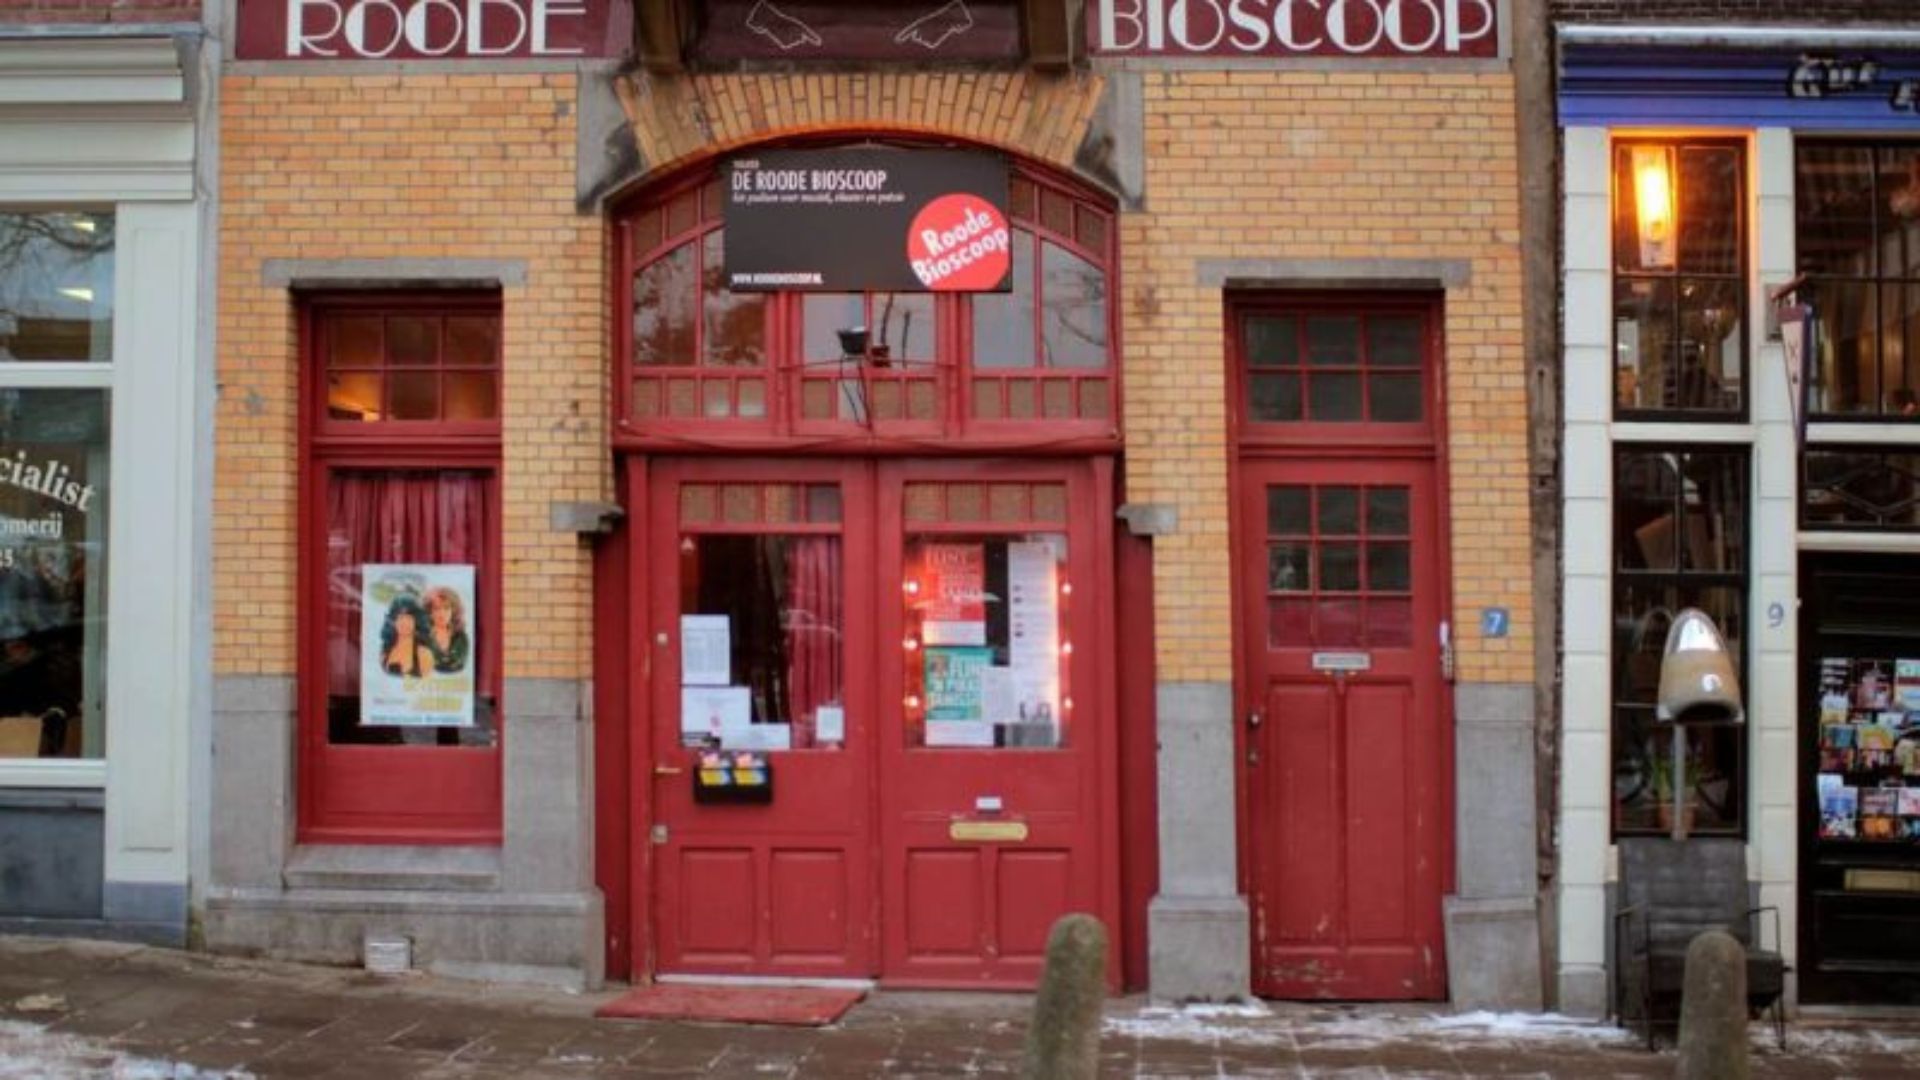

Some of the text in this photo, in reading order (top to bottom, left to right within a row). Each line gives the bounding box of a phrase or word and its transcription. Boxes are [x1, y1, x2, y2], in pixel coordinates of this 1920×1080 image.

[287, 0, 586, 57] ROODE
[1101, 0, 1493, 53] BIOSCOOP
[732, 170, 887, 190] DE ROODE BIOSCOOP
[922, 208, 993, 256] Roode
[912, 227, 1008, 286] Bioscoop
[1486, 611, 1502, 634] 7
[1767, 603, 1784, 627] 9
